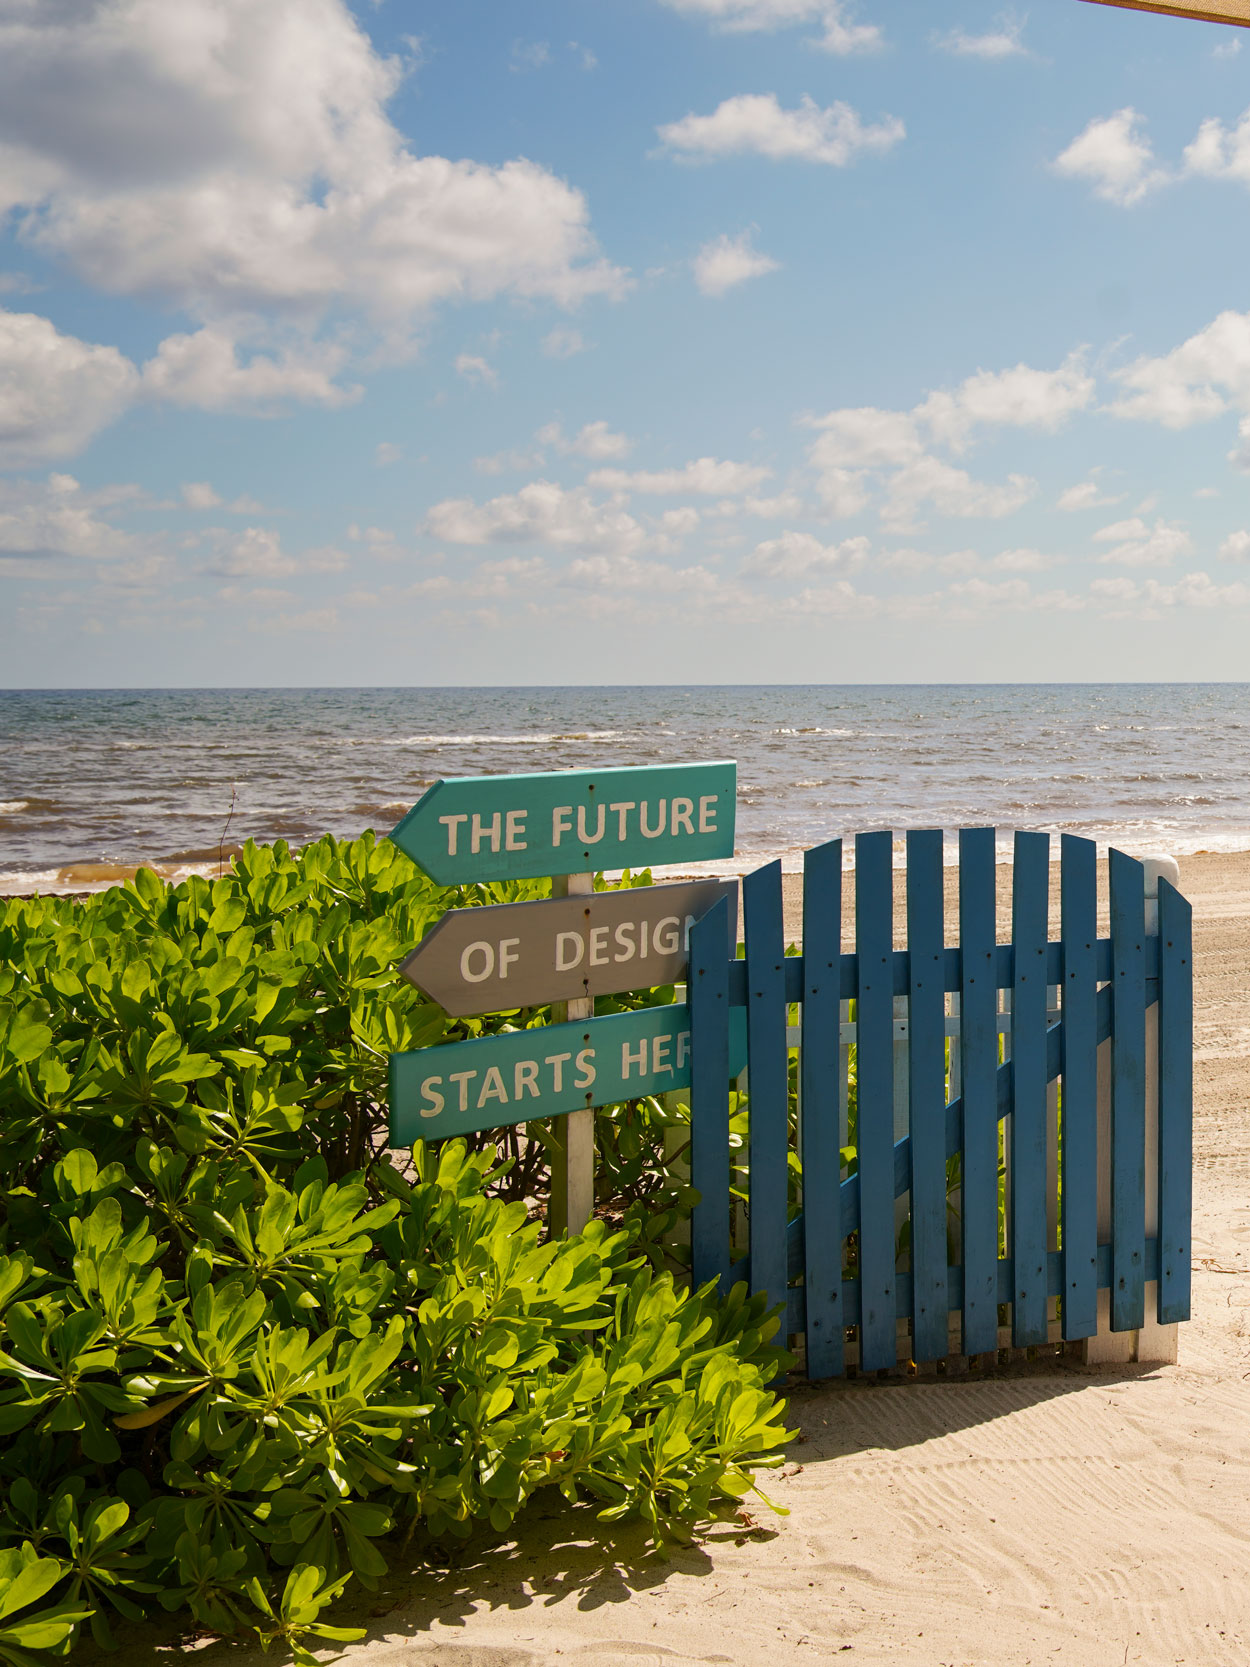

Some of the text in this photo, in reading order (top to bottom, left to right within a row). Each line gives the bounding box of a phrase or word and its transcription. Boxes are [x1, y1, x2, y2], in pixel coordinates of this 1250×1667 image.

[438, 794, 719, 856] THE FUTURE
[460, 937, 521, 984] OF
[419, 1048, 597, 1118] STARTS
